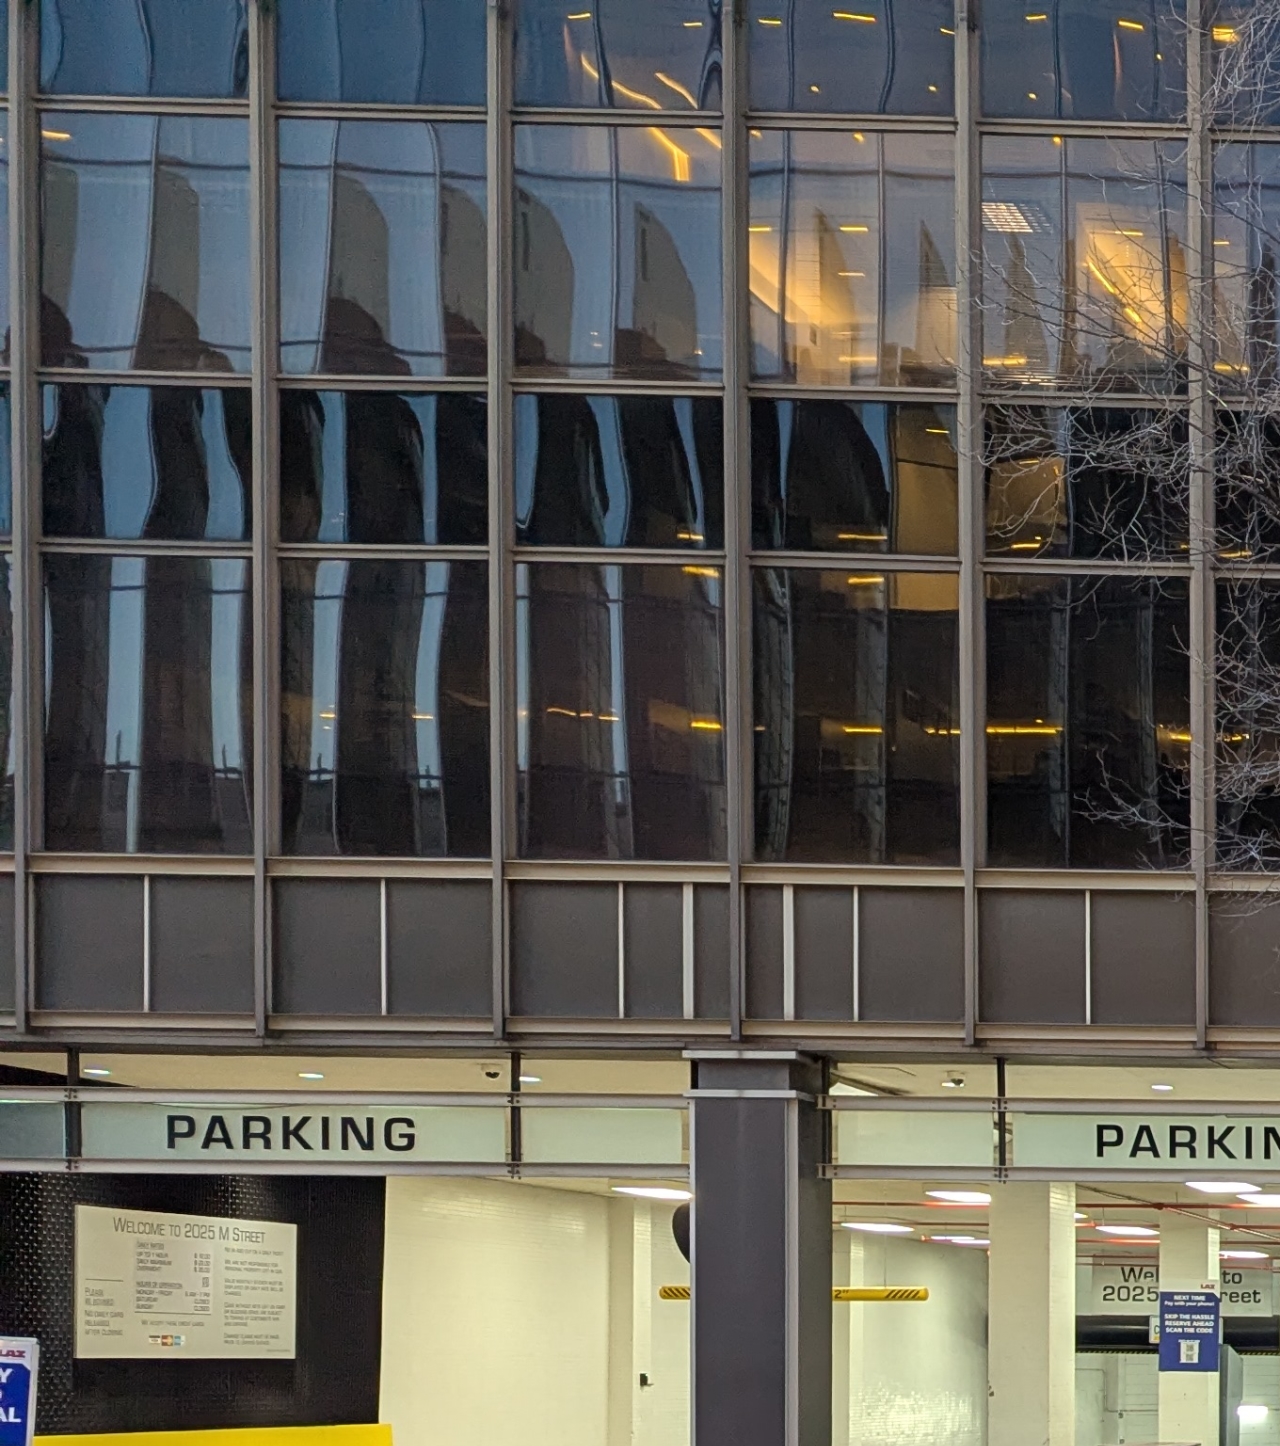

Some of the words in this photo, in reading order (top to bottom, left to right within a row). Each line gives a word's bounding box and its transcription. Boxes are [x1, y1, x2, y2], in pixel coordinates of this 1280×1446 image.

[166, 1114, 416, 1152] PARKING
[113, 1217, 166, 1237] WELCOME
[169, 1224, 182, 1238] TO
[184, 1223, 216, 1241] 2025
[218, 1226, 229, 1241] M
[232, 1227, 266, 1244] STREET
[1222, 1270, 1243, 1285] to
[1103, 1285, 1160, 1302] 2025
[1219, 1289, 1262, 1304] reet
